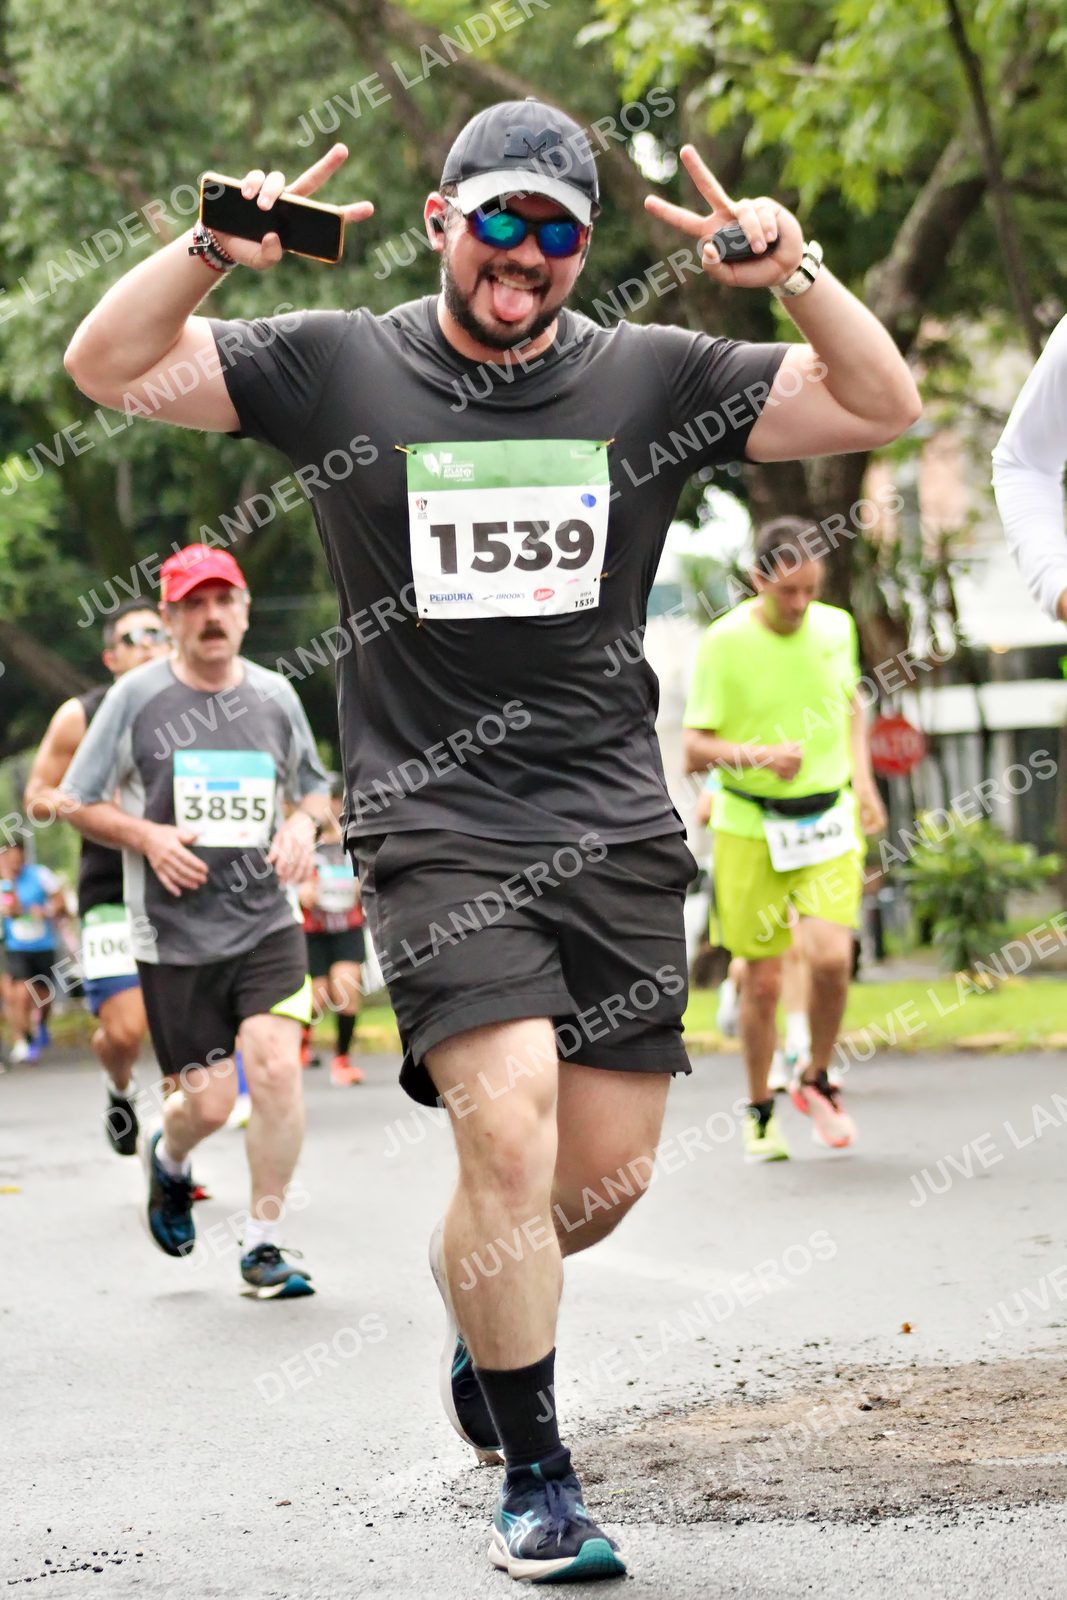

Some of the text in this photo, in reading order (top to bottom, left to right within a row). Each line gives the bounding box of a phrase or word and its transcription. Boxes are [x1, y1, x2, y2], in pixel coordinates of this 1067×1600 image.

[430, 519, 595, 575] 1539
[574, 597, 595, 608] 1539
[184, 795, 267, 822] 3855
